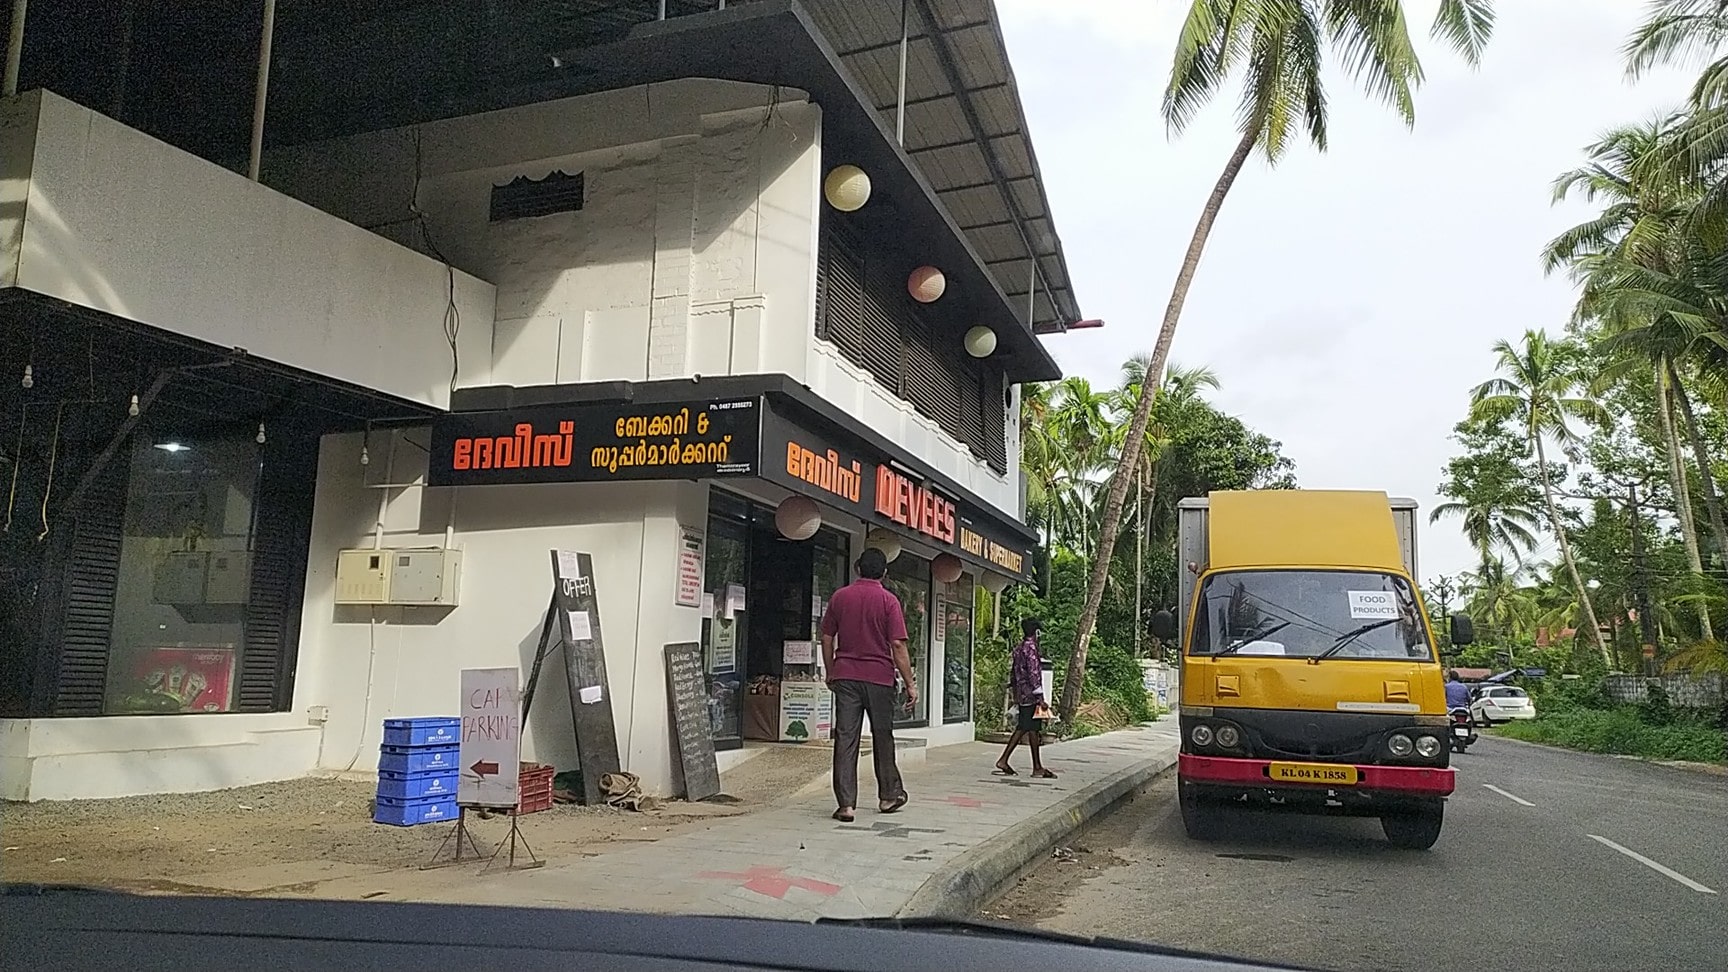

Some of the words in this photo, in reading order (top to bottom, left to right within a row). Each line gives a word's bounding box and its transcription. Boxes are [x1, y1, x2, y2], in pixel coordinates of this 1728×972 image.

[615, 407, 689, 438] ബേക്കറി
[697, 412, 709, 435] &
[453, 421, 575, 470] ദേവീസ്
[786, 441, 862, 503] ദേവീസ്
[875, 463, 955, 544] DEVEES
[960, 526, 983, 557] BAKERY
[990, 541, 1023, 574] SUPERMARKET
[563, 575, 593, 598] OFFER
[1359, 595, 1386, 604] FOOD
[1352, 606, 1396, 614] PRODUCTS
[462, 715, 519, 742] PARKING
[1281, 768, 1296, 777] KL
[1298, 769, 1311, 778] 04
[1313, 770, 1321, 778] K
[1323, 770, 1347, 780] 1858
